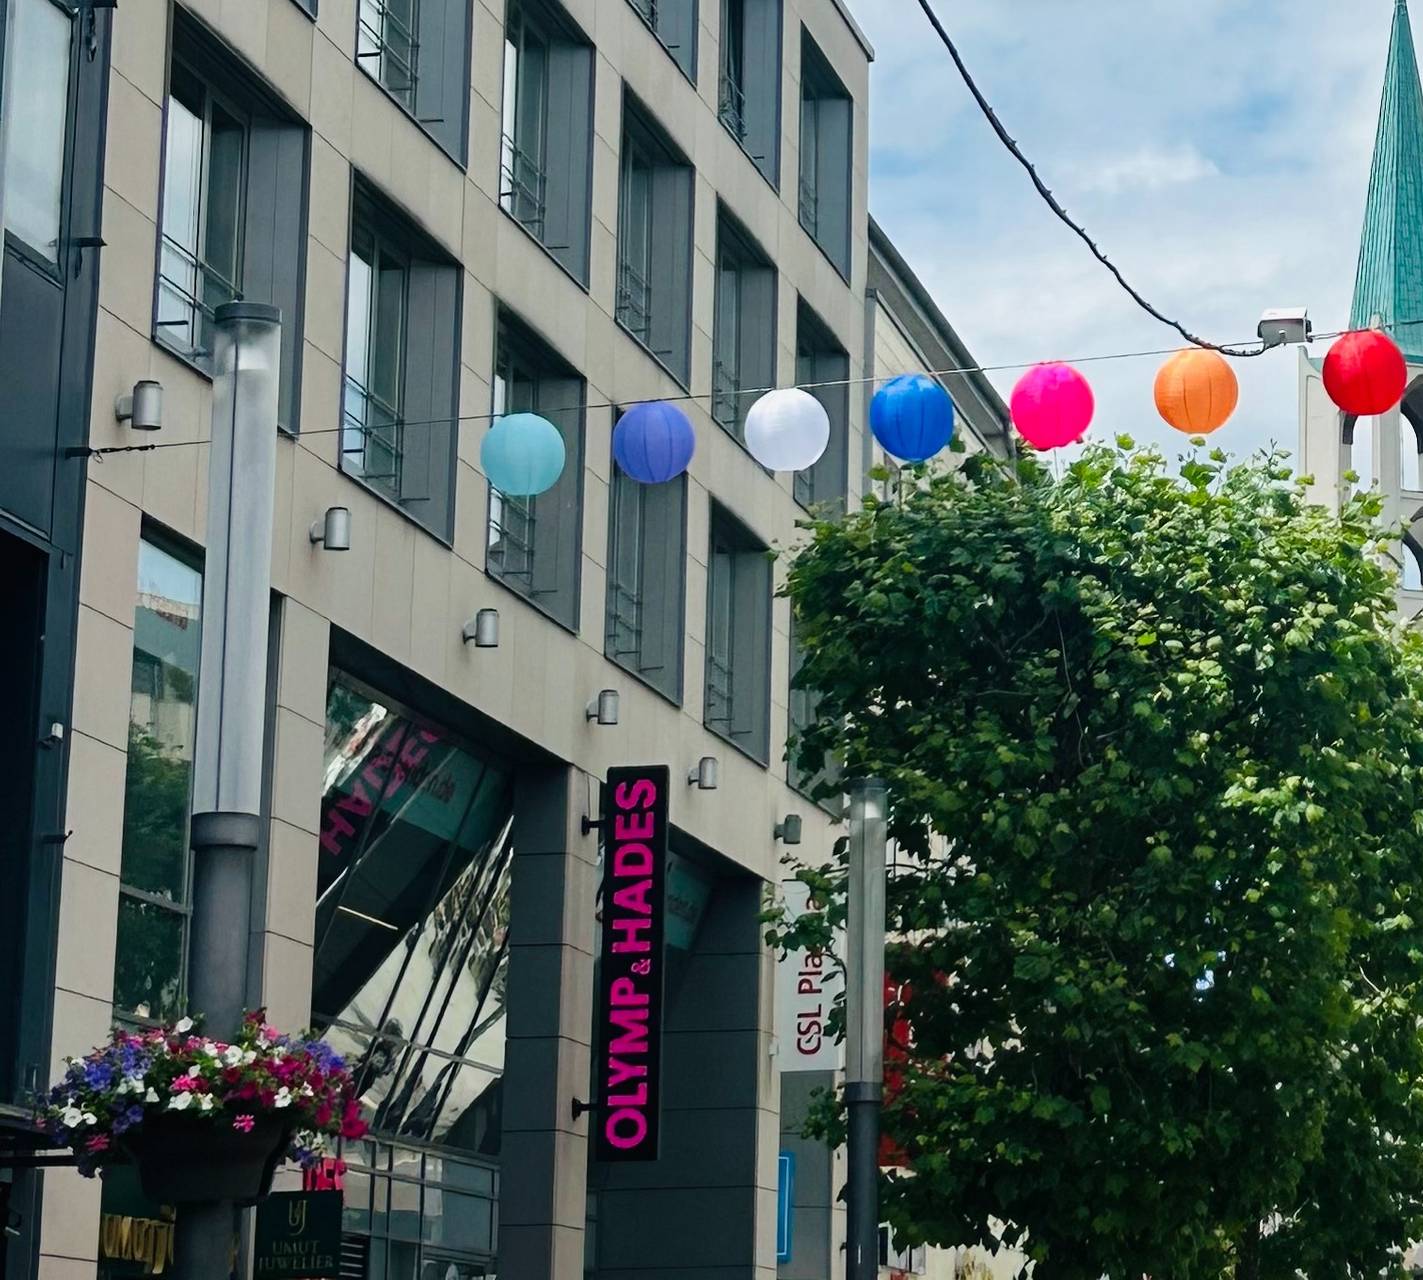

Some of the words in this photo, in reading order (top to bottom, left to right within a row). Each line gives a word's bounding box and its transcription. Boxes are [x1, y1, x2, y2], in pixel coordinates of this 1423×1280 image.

[611, 778, 657, 953] HADES
[631, 959, 651, 976] &
[797, 1003, 822, 1056] CSL
[605, 976, 650, 1150] OLYMP
[272, 1239, 320, 1256] UMUT
